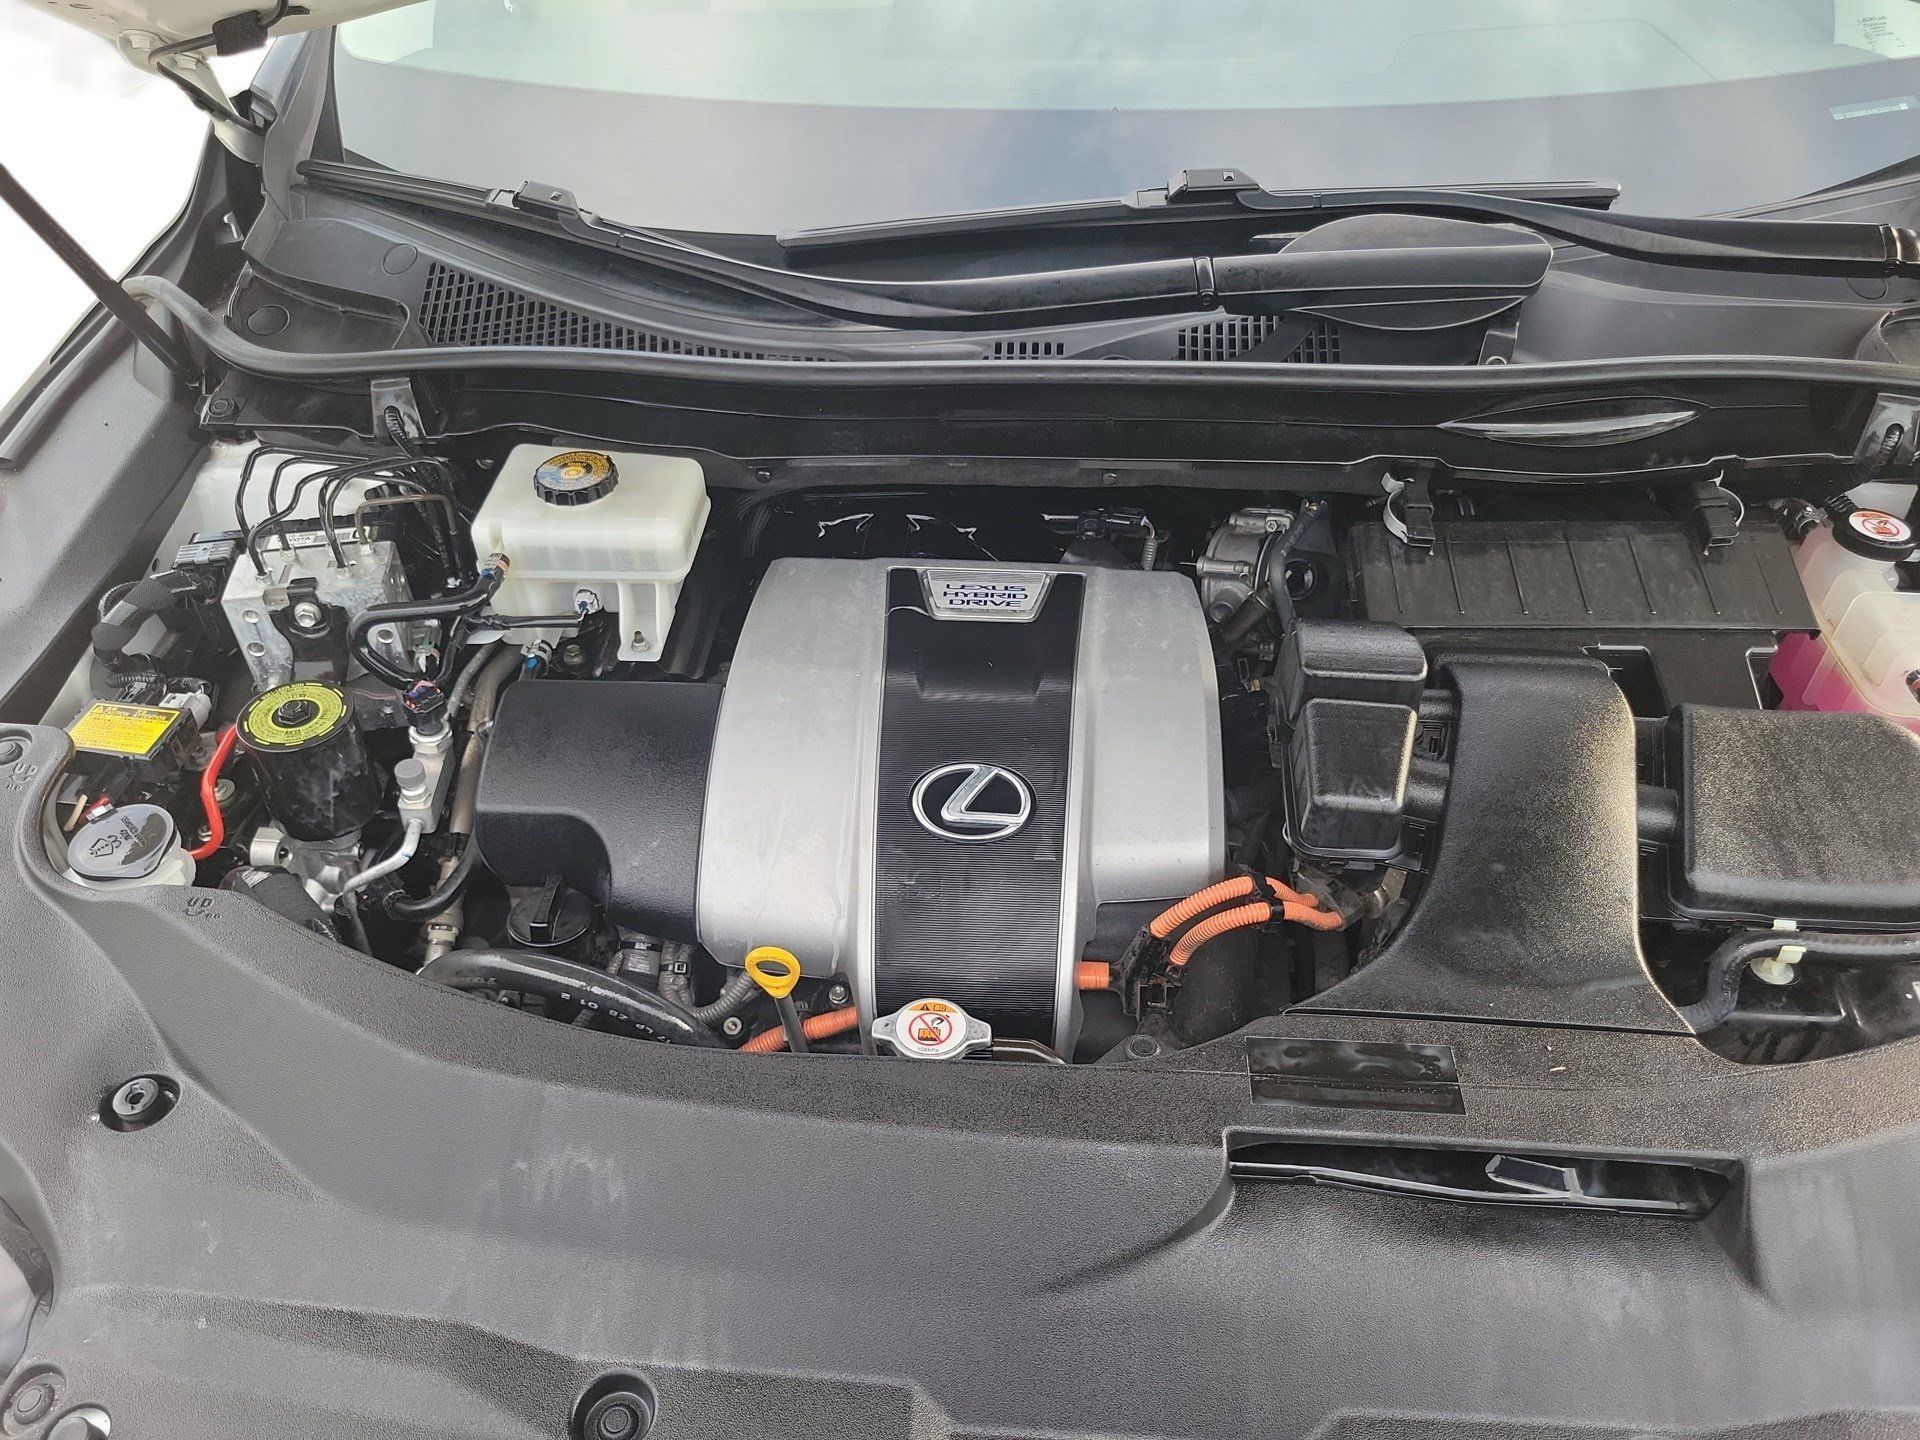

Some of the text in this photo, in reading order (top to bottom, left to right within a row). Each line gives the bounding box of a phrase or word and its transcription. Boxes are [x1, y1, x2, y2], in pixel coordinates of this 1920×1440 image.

[946, 583, 1026, 592] LEXUS
[942, 591, 1029, 600] HYBRID
[949, 599, 1022, 608] DRIVE
